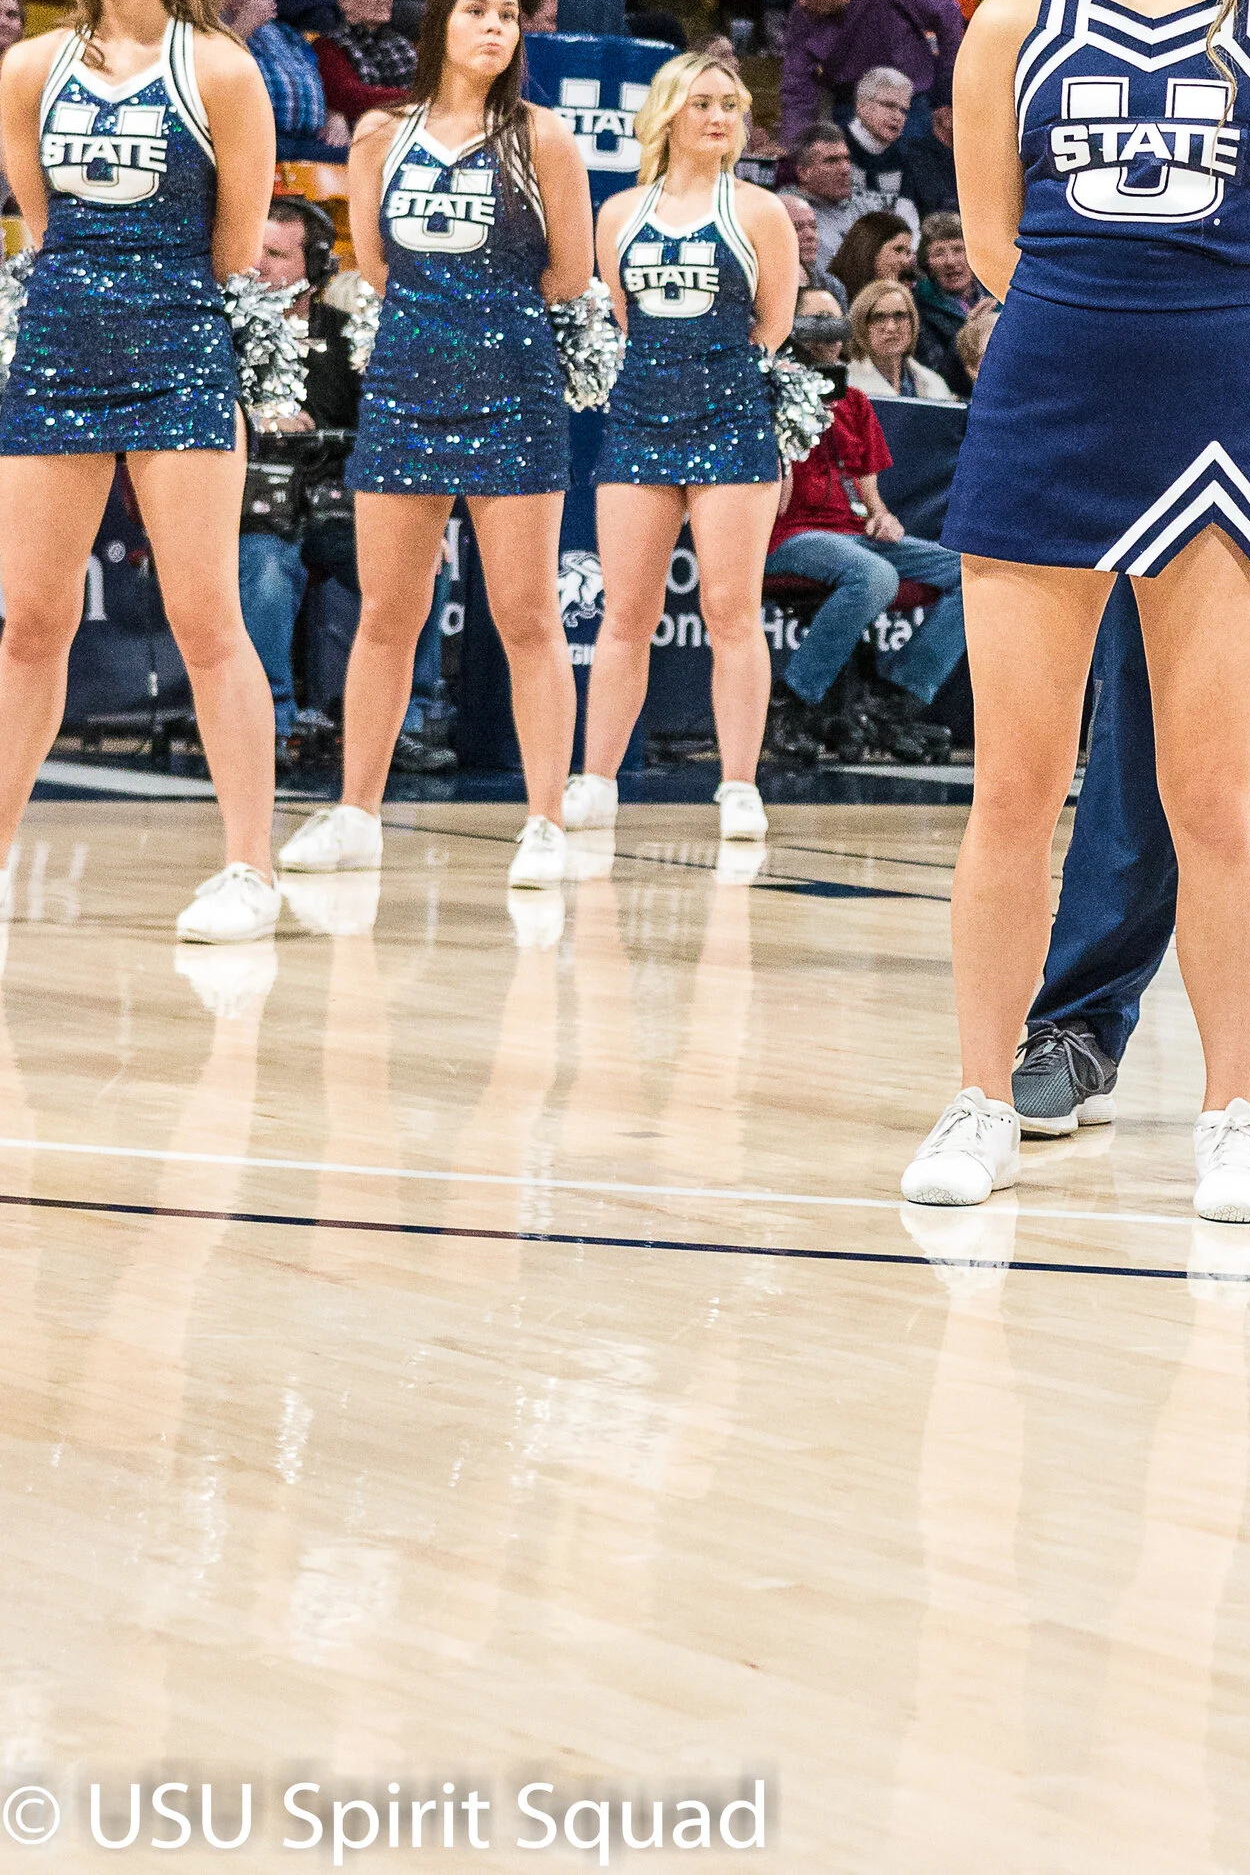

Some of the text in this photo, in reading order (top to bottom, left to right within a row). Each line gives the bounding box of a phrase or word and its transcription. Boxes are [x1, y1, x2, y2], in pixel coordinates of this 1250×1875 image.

[555, 106, 634, 137] STAT
[42, 132, 168, 173] STATE
[1050, 122, 1241, 175] STATE
[387, 189, 496, 226] STATE
[623, 265, 720, 293] STATE
